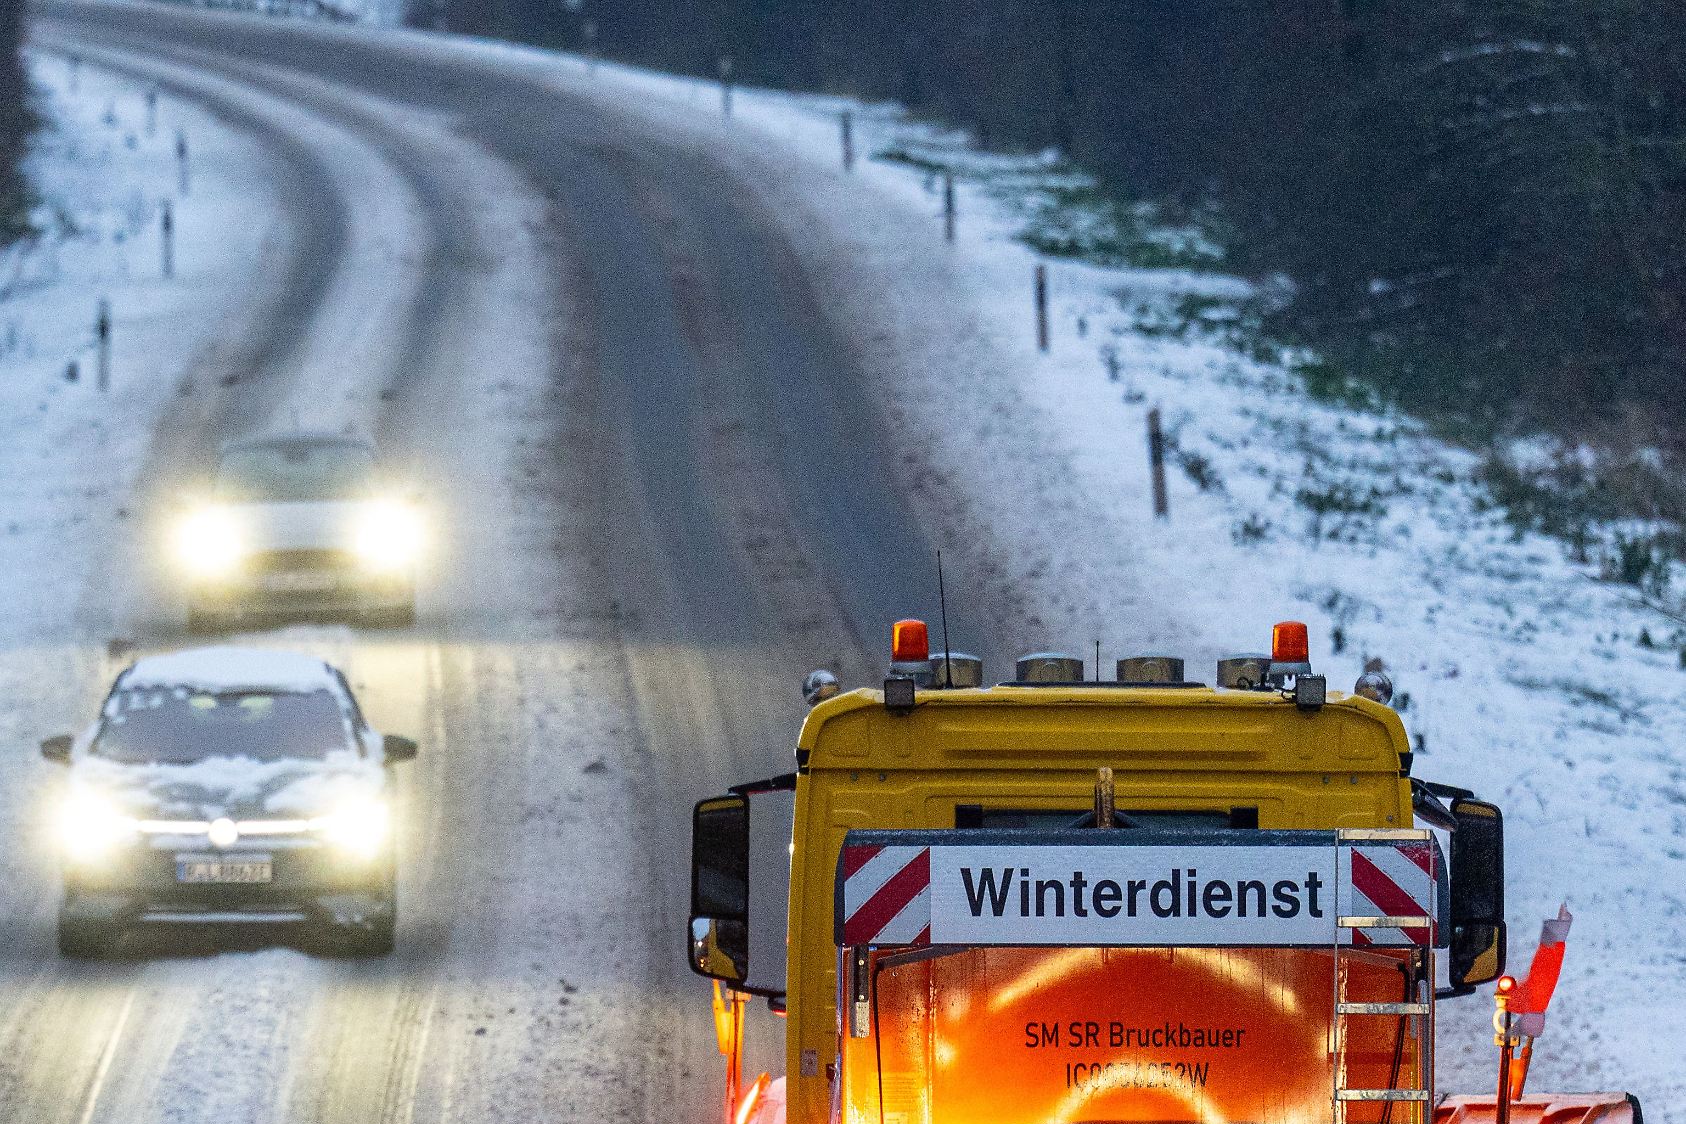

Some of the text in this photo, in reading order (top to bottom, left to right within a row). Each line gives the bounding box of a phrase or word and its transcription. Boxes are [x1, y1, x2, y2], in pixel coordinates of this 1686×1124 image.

[960, 867, 1323, 919] Winterdienst
[1025, 1022, 1246, 1048] SM SR Bruckbauer
